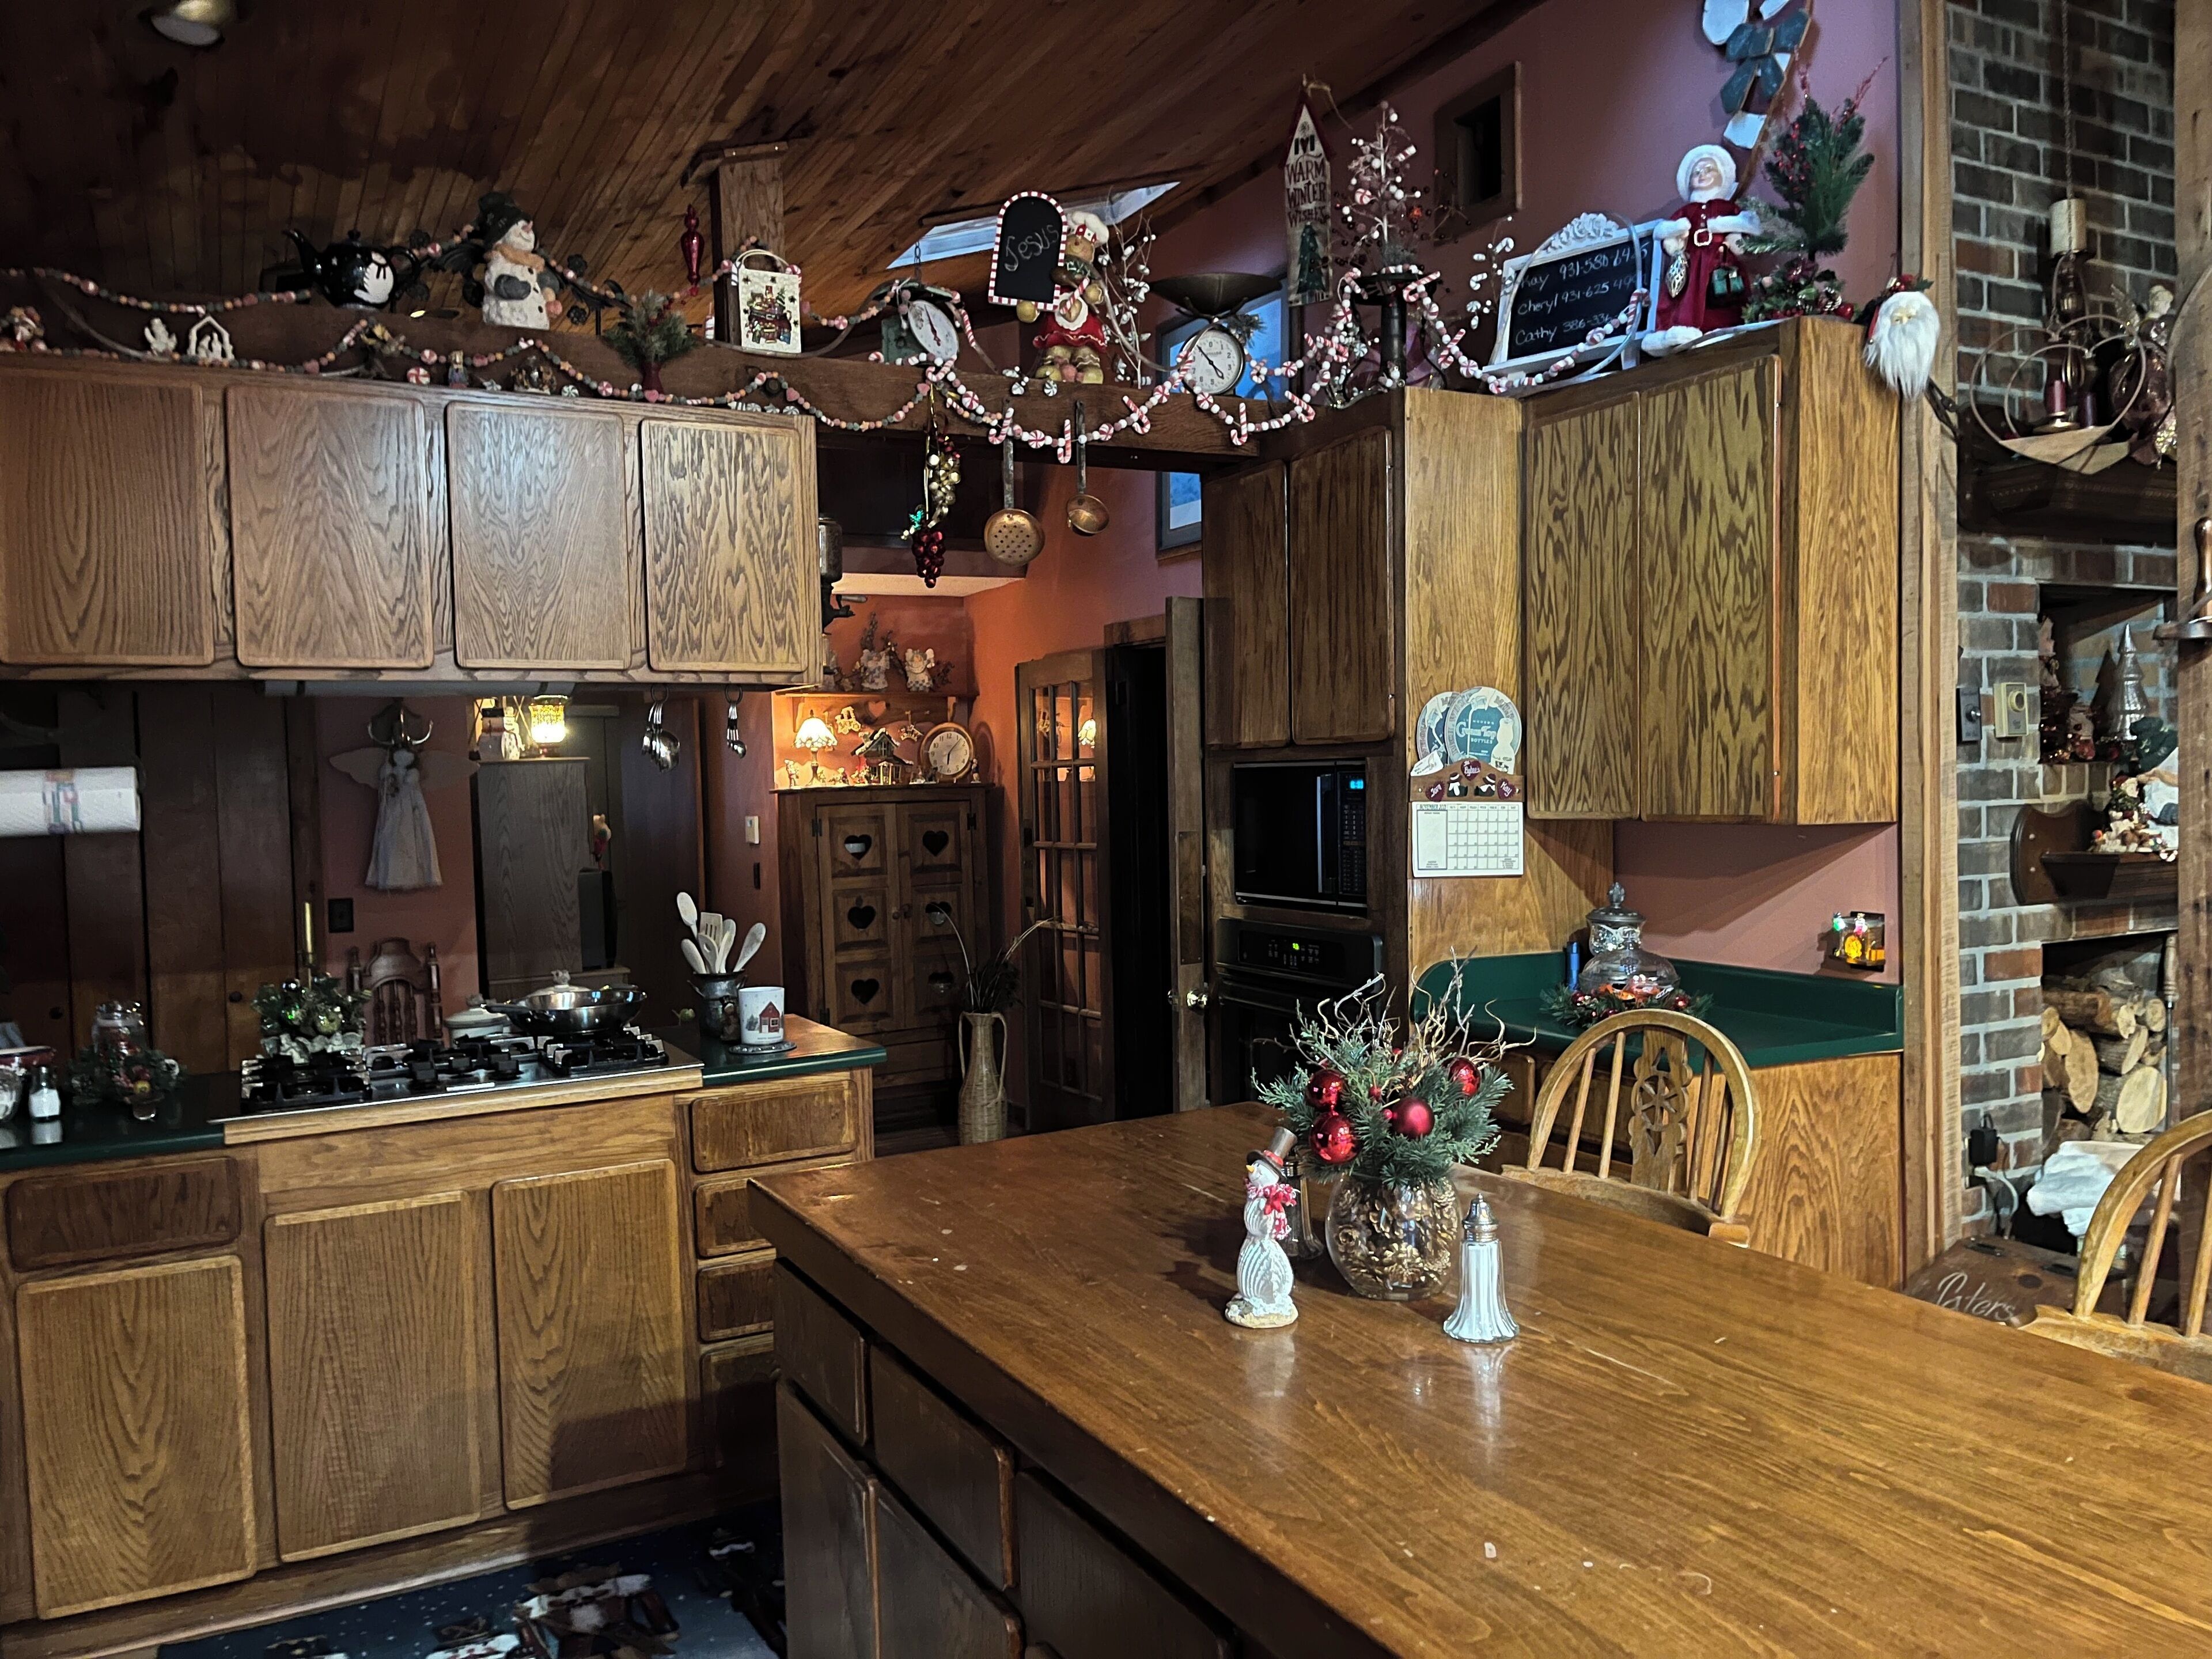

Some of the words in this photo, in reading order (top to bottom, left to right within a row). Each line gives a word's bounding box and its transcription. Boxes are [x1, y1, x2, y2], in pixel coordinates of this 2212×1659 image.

[1285, 158, 1325, 185] WARM
[1286, 181, 1326, 208] WINTER
[1288, 207, 1330, 228] WISHES
[1004, 225, 1059, 271] Jesus
[1518, 293, 1558, 315] Cheryl
[1516, 326, 1558, 345] Cathy
[1493, 695, 1515, 719] MILK
[1500, 781, 1513, 797] Kay
